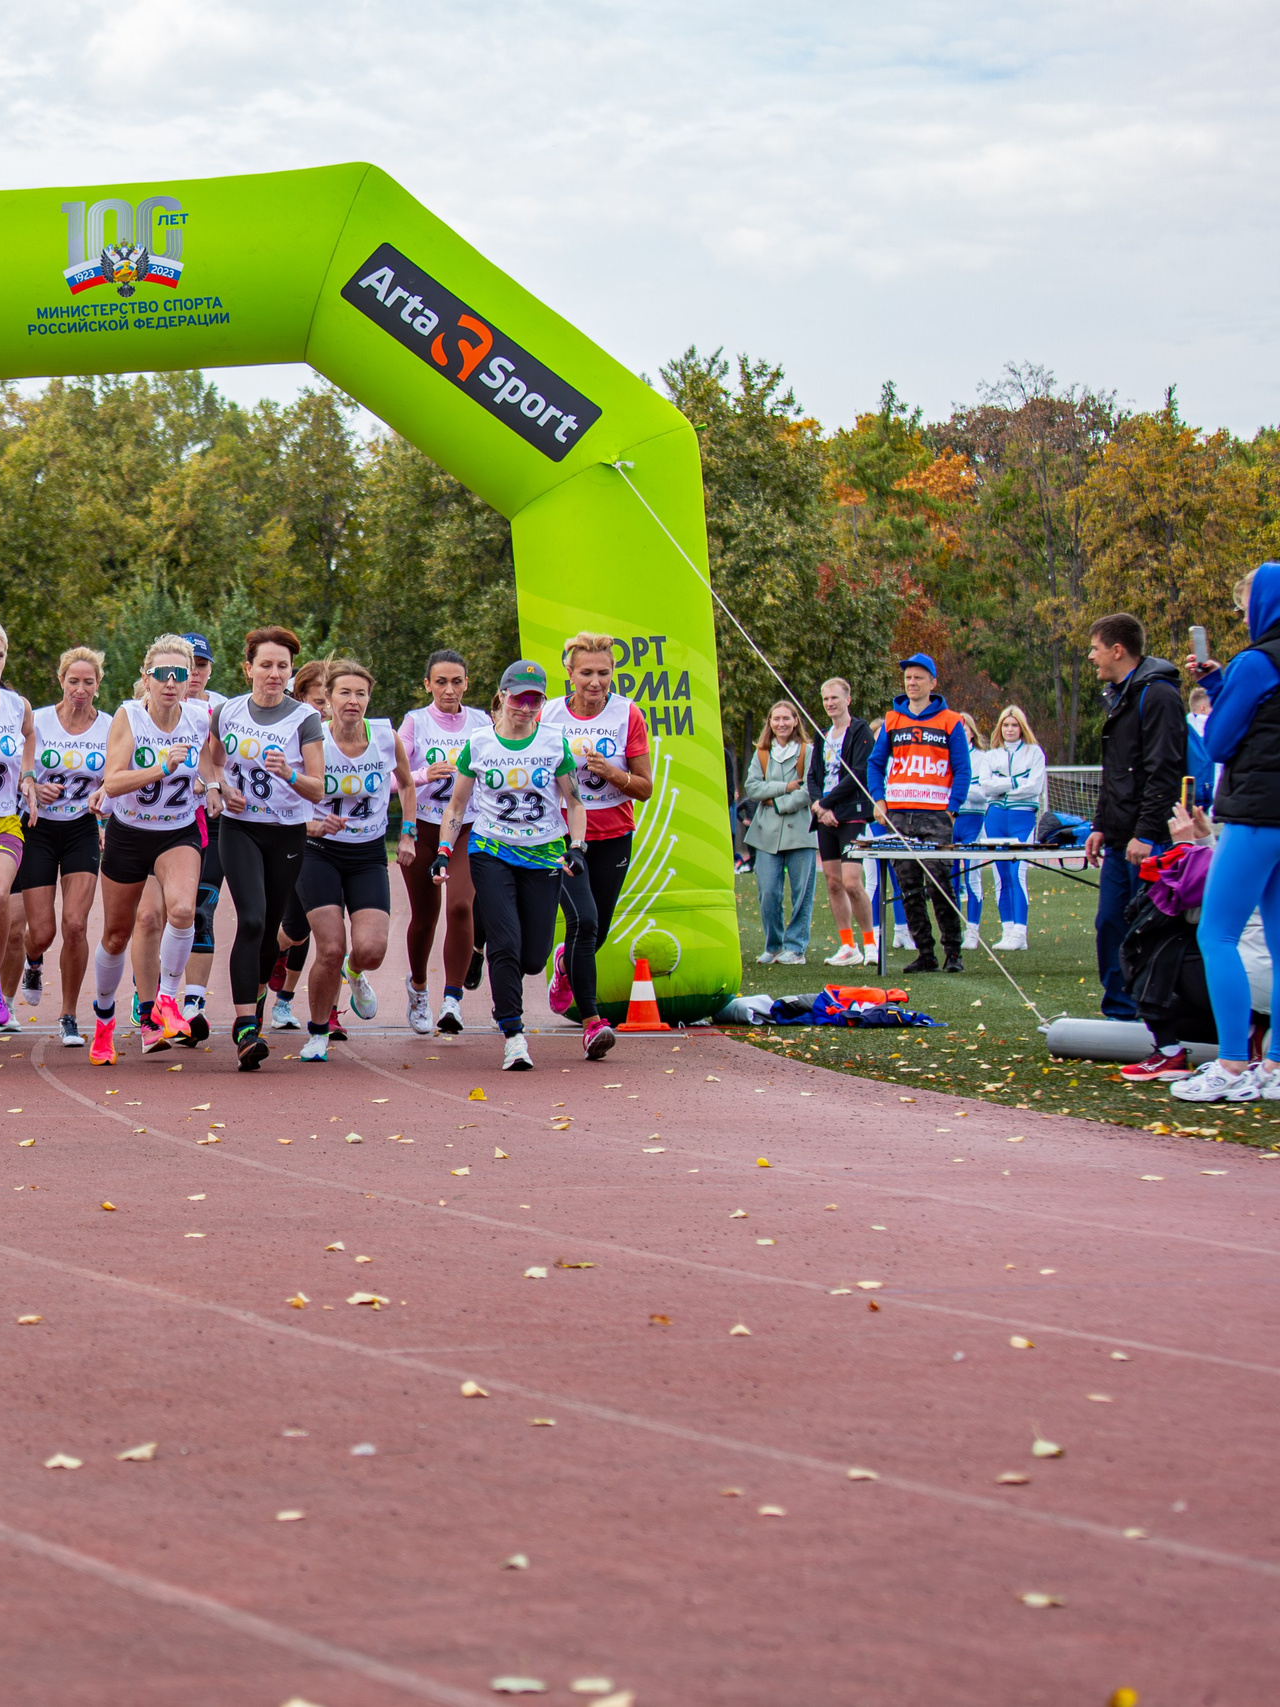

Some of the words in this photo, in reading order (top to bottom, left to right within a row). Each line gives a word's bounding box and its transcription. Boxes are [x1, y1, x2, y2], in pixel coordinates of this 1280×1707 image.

[157, 213, 189, 226] ЛЕТ
[74, 269, 96, 283] 1923
[151, 265, 175, 278] 2023
[36, 300, 159, 320] МИНИСТЕРСТВО
[163, 296, 223, 312] СПОРТА
[27, 316, 129, 336] РОССИЙСКОЙ
[133, 312, 231, 330] ФЕДЕРАЦИИ
[358, 266, 440, 337] Arta
[478, 356, 579, 444] Sport
[562, 635, 667, 669] ОРТ
[565, 727, 618, 737] ARAFONE
[893, 732, 912, 743] Arta
[922, 732, 947, 744] Sport
[41, 739, 107, 751] VMARAFONE
[424, 738, 469, 747] VMARAF
[325, 761, 384, 774] MARAFONE
[483, 757, 552, 767] VMARAFONE
[892, 754, 949, 777] СУДЬЯ
[230, 762, 273, 801] 18
[136, 774, 192, 808] 92
[324, 796, 375, 820] 14
[496, 791, 547, 823] 23
